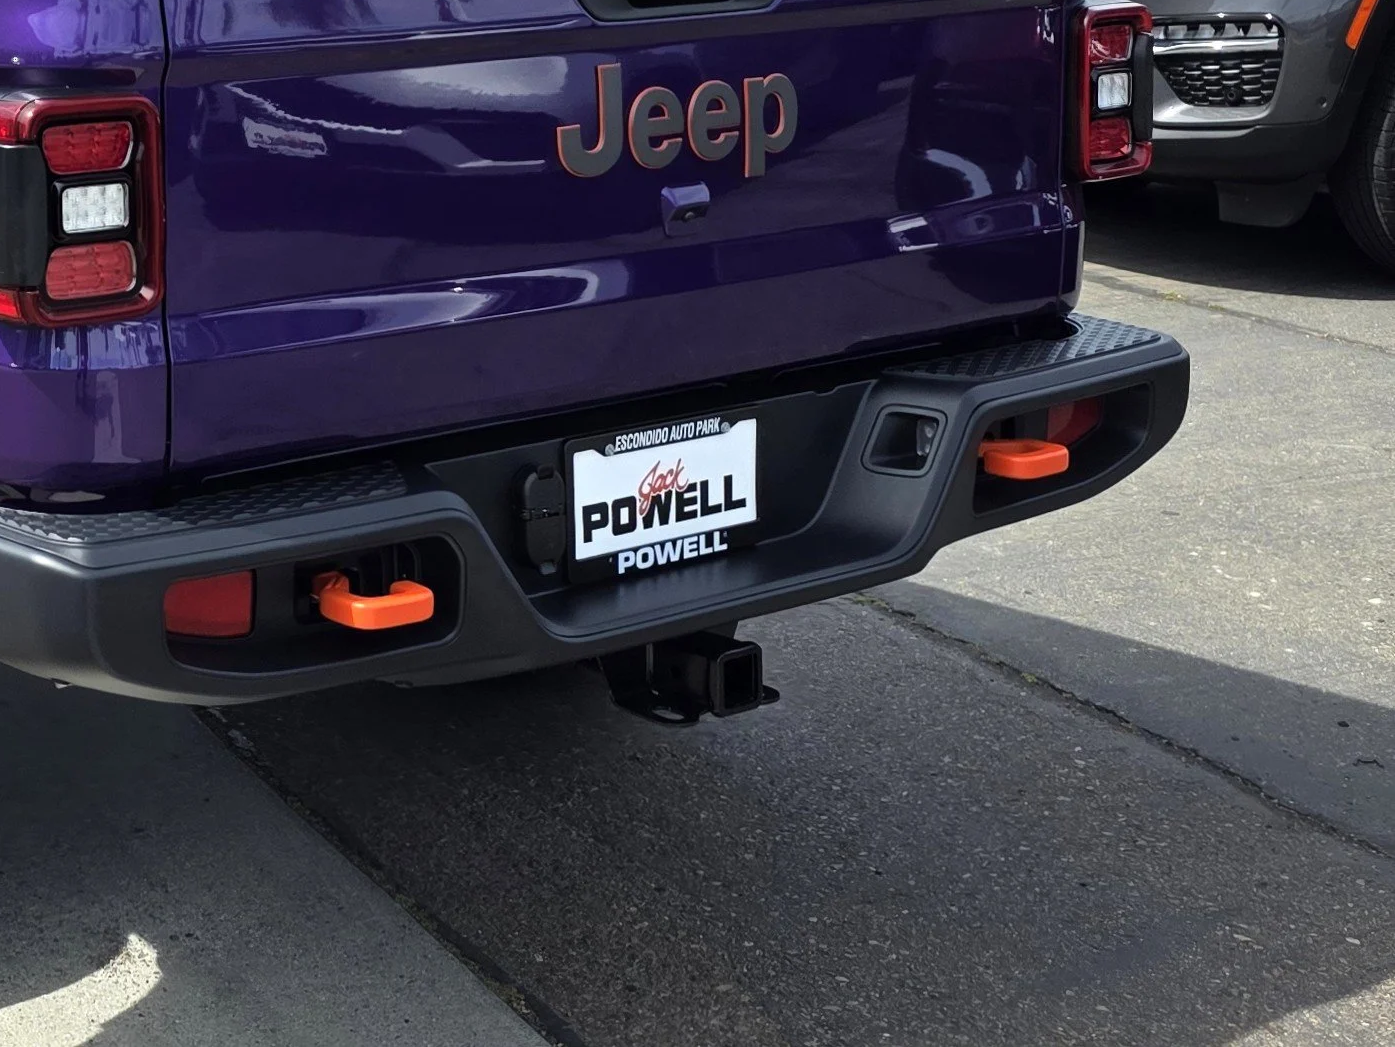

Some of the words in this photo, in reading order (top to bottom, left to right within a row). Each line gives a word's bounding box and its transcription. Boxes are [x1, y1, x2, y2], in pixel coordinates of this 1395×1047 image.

[556, 62, 798, 178] Jeep
[614, 428, 669, 453] ESCONDIDO
[669, 421, 696, 442] AUTO
[695, 416, 722, 437] PARK
[581, 474, 747, 544] POWELL
[637, 457, 689, 517] Jack
[617, 530, 728, 575] POWELL
